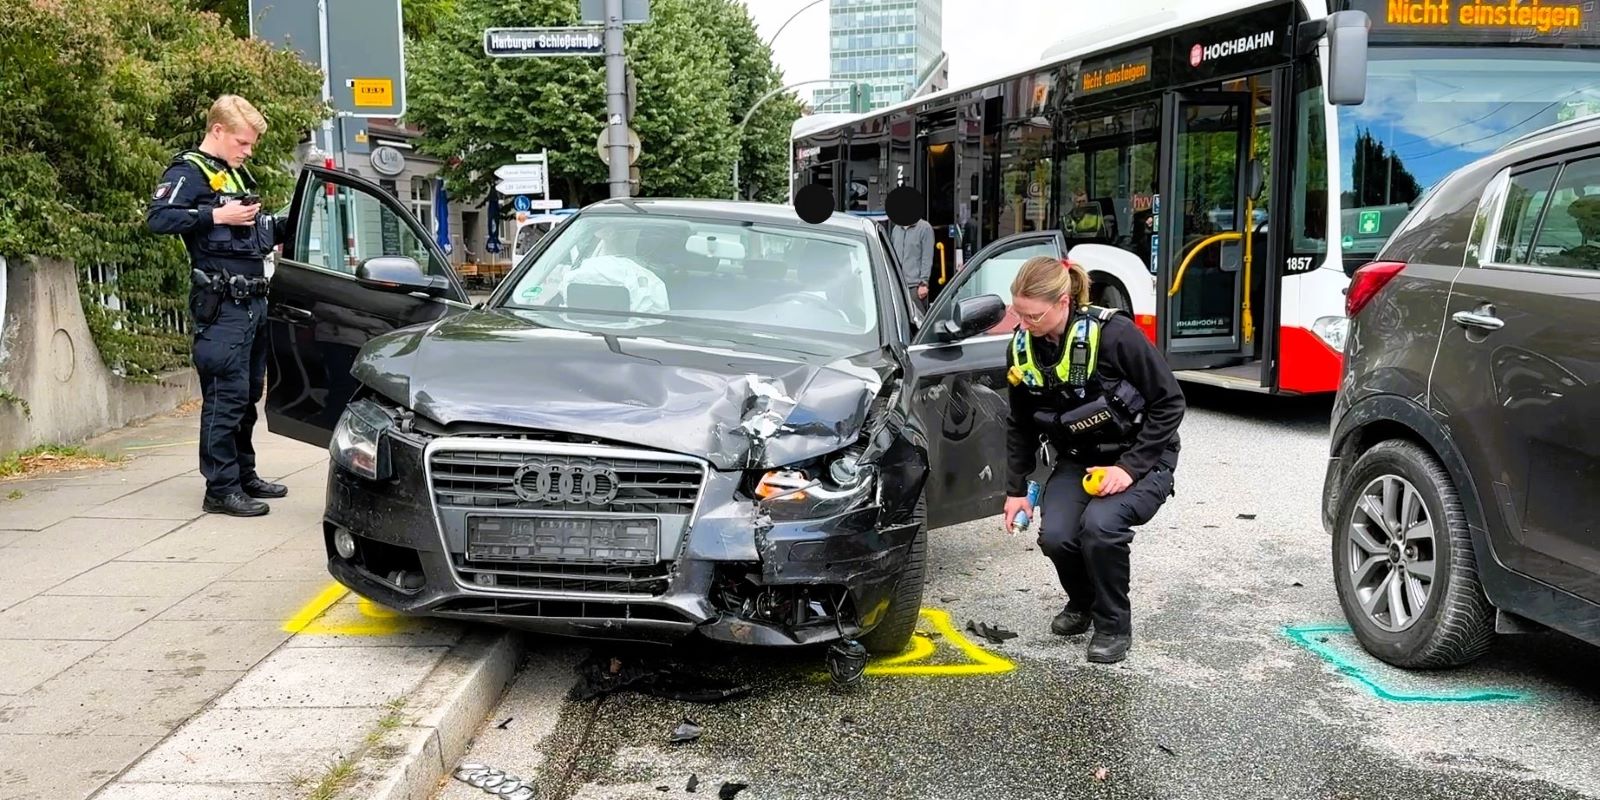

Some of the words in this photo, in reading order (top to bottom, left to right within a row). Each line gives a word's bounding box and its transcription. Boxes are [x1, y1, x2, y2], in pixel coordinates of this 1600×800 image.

[1387, 0, 1449, 24] Nicht
[1459, 0, 1580, 31] einsteigen
[491, 34, 537, 50] Harburger
[538, 33, 600, 49] Schloßstraße
[1203, 30, 1275, 61] HOCHBAHN
[1082, 70, 1102, 90] Nicht
[1104, 64, 1147, 87] einsteigen
[1133, 193, 1153, 209] hvv
[1286, 257, 1313, 270] 1857
[1069, 410, 1112, 432] POLIZEI
